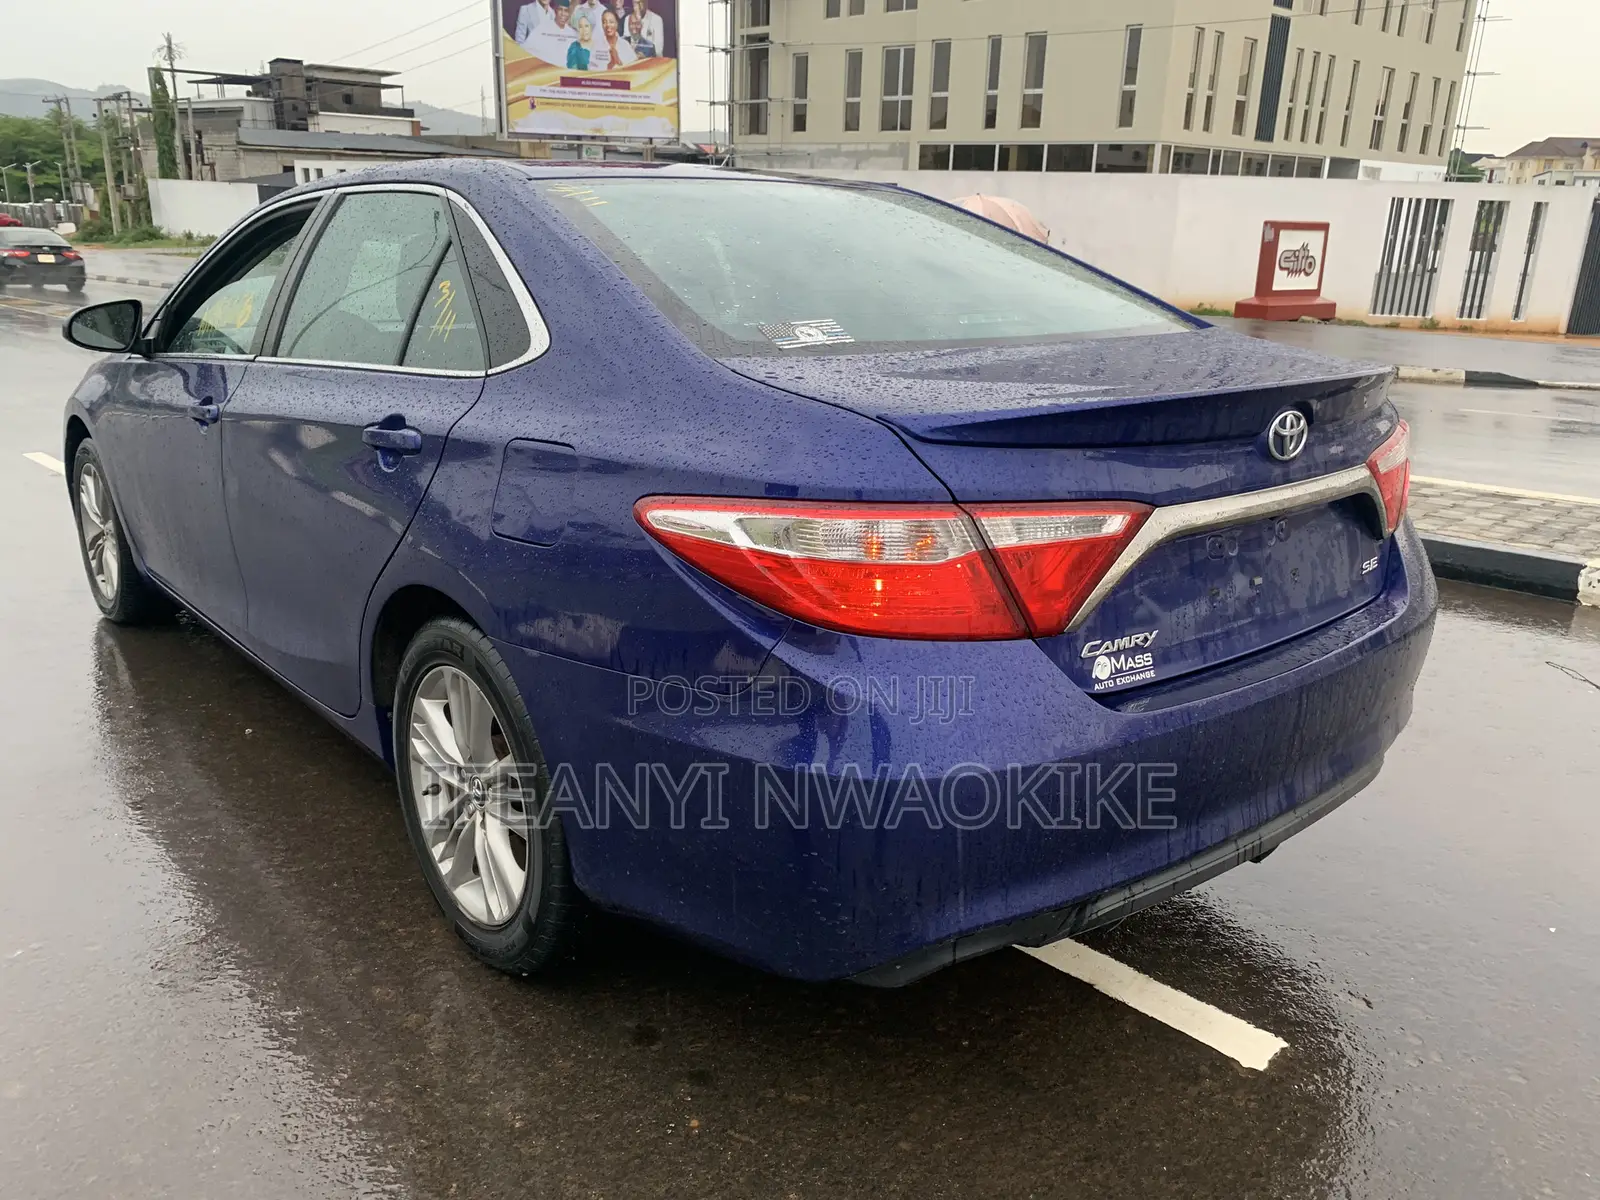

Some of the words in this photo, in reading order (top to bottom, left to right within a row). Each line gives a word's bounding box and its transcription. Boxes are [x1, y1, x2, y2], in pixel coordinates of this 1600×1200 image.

[1361, 557, 1378, 574] SE
[1081, 630, 1158, 658] CAMRY
[1094, 680, 1114, 691] AUTO
[1116, 670, 1155, 685] EXCHANGE
